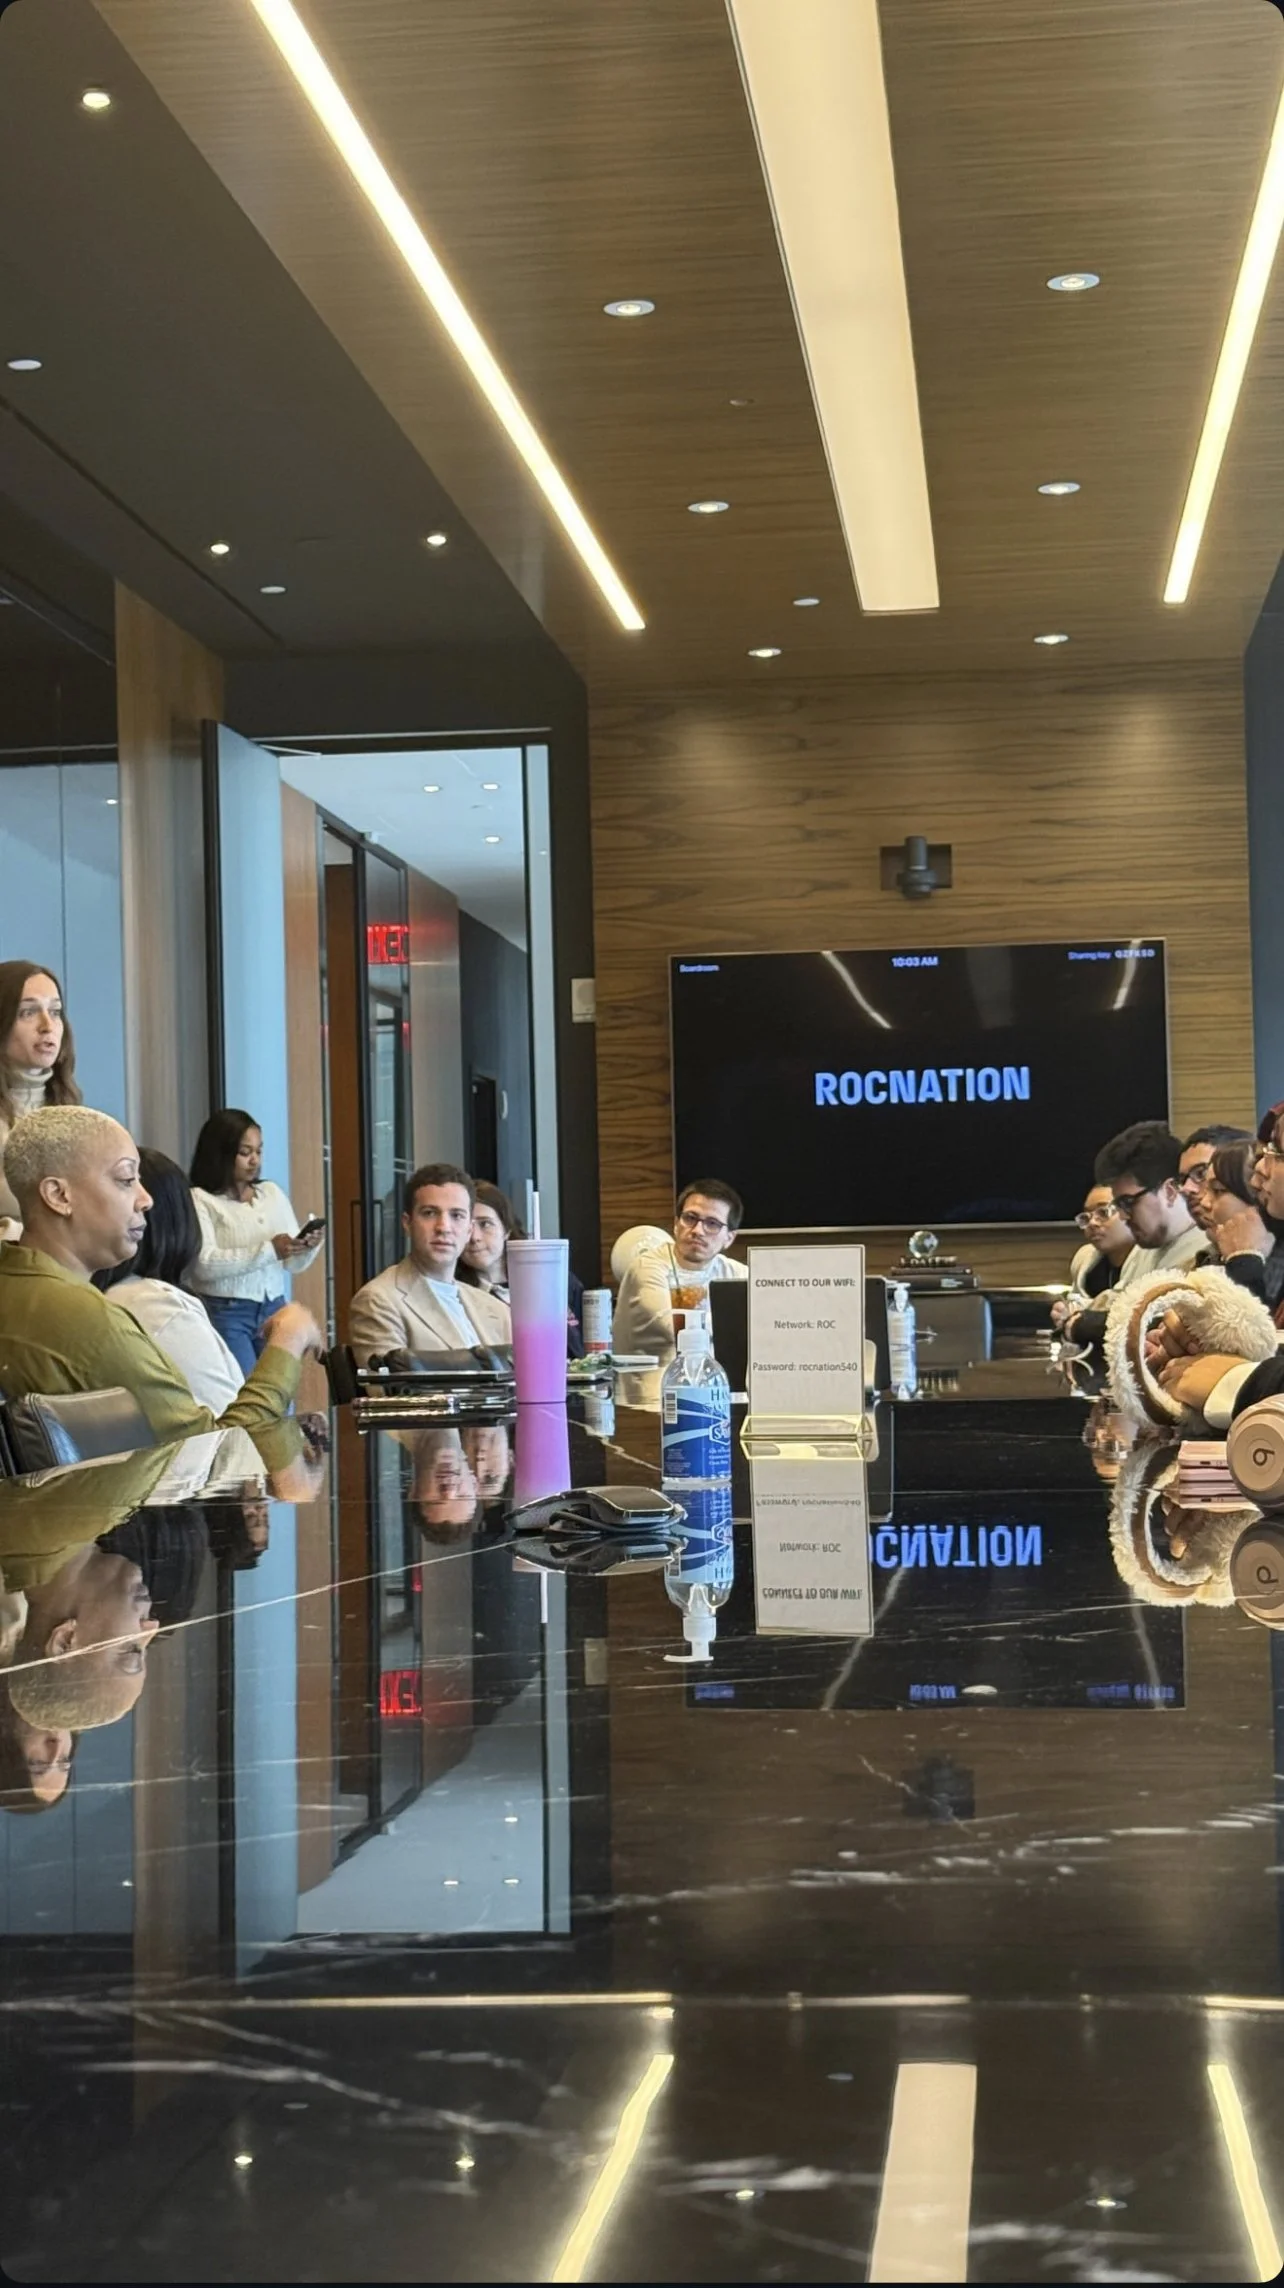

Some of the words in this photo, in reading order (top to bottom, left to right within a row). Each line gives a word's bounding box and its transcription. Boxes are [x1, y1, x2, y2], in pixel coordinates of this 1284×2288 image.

[892, 957, 919, 967] 10:03
[921, 956, 938, 966] AM
[815, 1066, 1030, 1106] ROCNATION
[755, 1279, 796, 1288] CONNECT
[799, 1279, 810, 1288] TO
[811, 1279, 831, 1288] OUR
[833, 1278, 856, 1287] WIFI:
[774, 1320, 815, 1329] Network:
[816, 1320, 836, 1329] ROC
[752, 1362, 797, 1372] Password:
[799, 1362, 858, 1372] rocnation540
